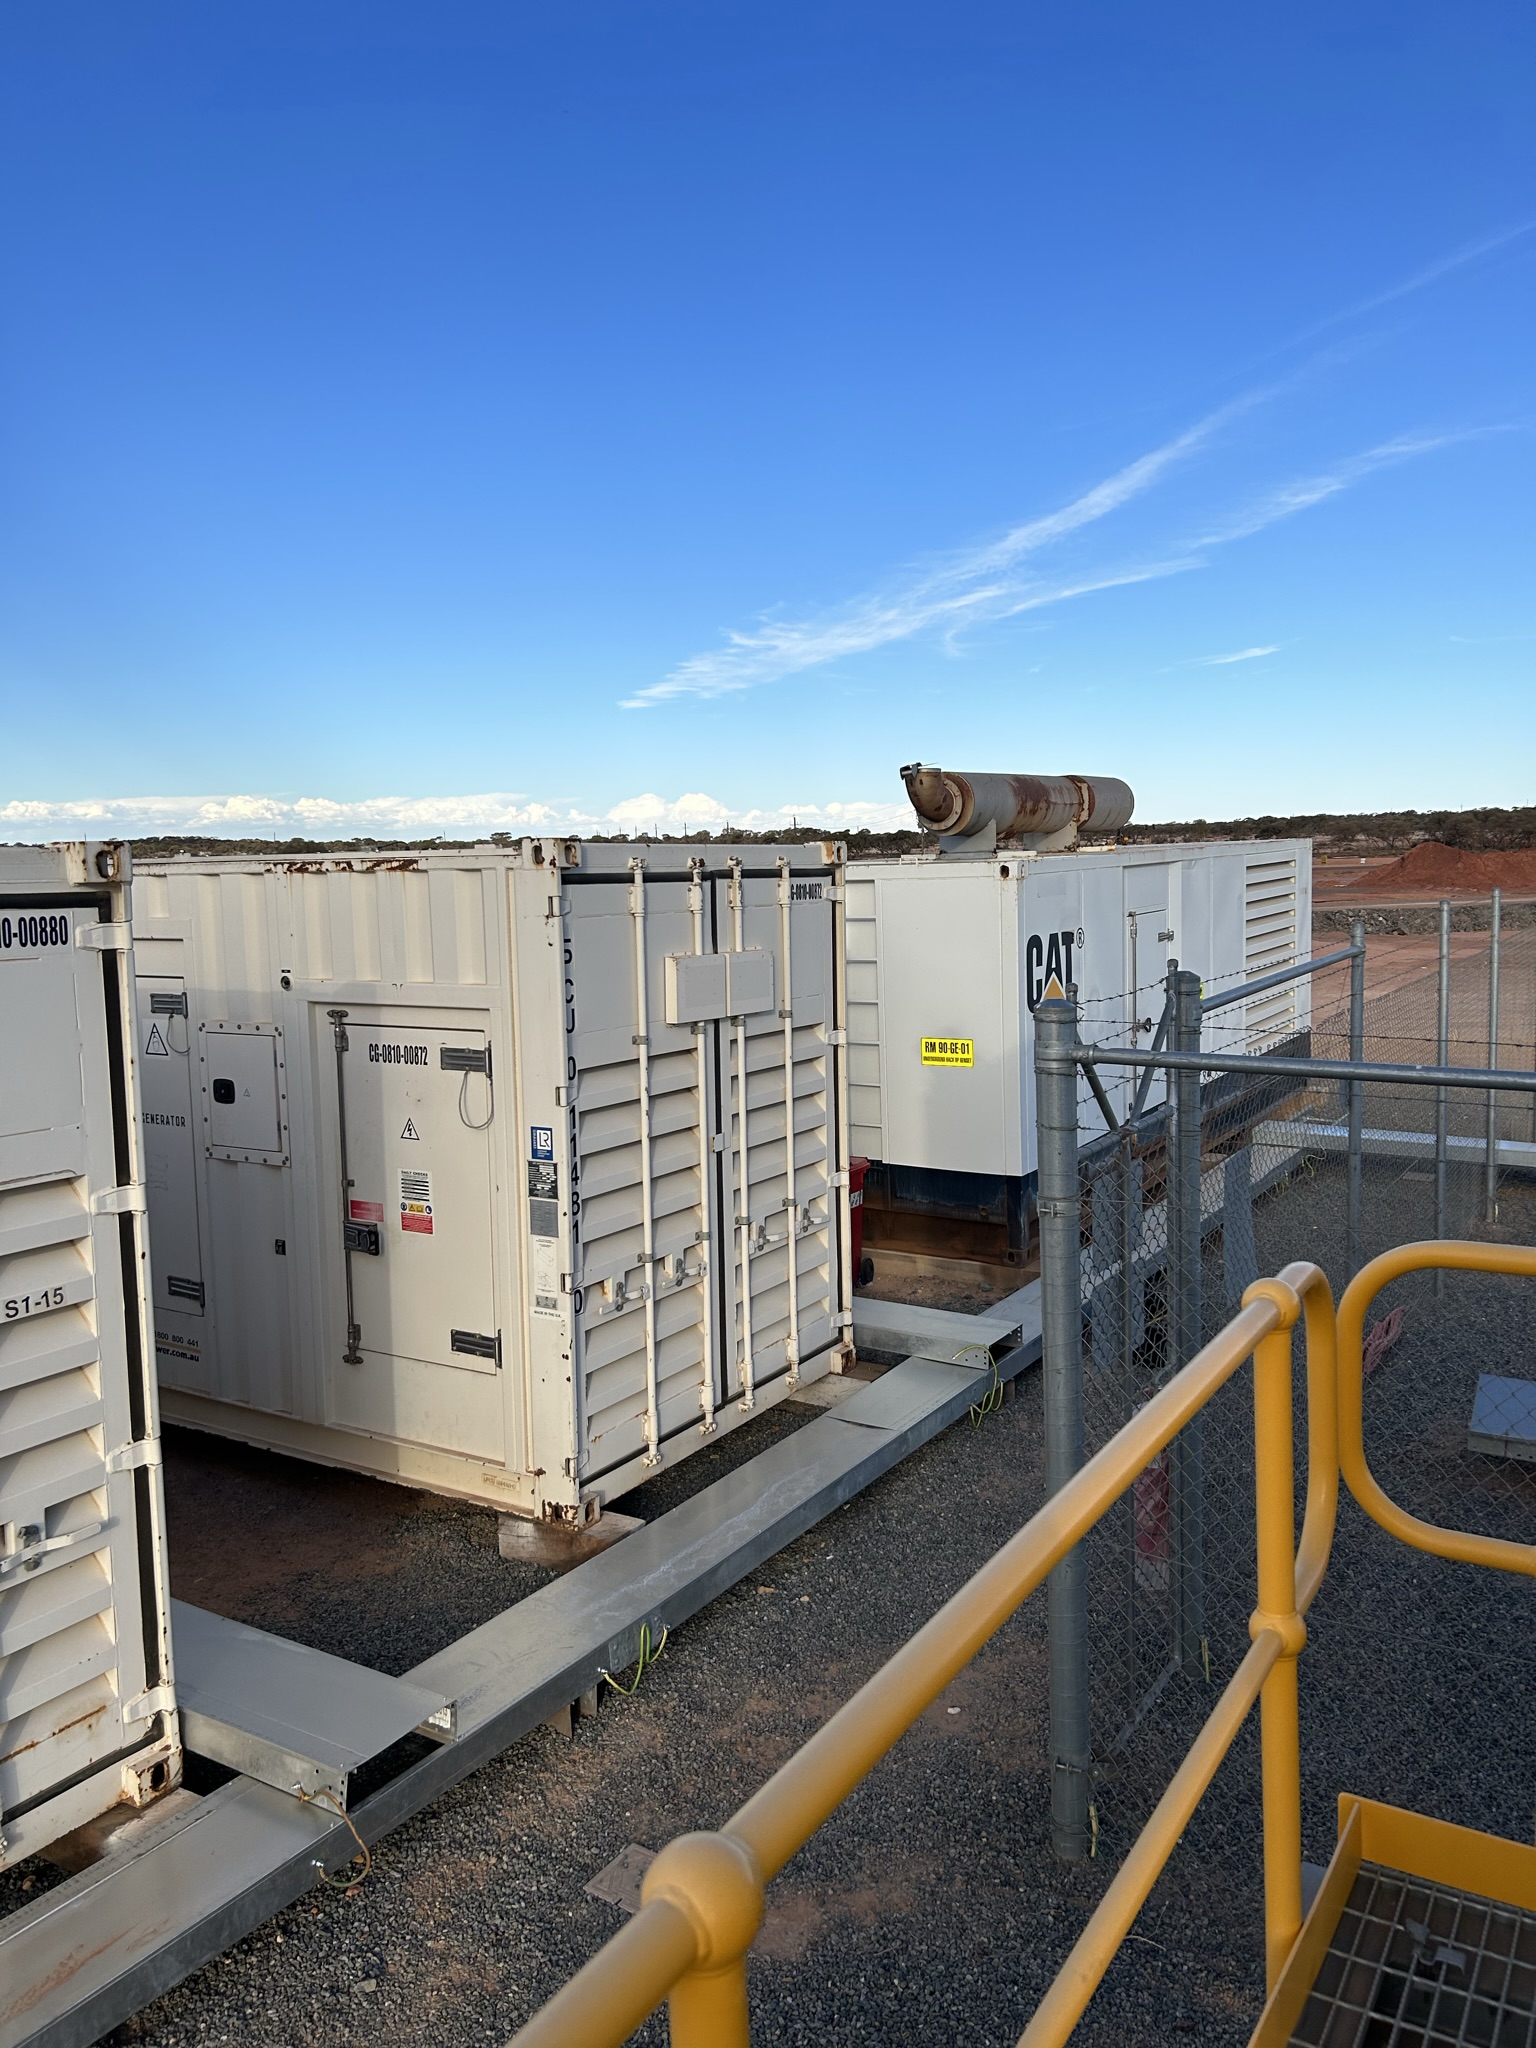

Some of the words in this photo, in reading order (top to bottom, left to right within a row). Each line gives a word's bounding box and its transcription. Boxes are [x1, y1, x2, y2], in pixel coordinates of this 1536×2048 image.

[0, 915, 69, 949] 0-00880
[369, 1043, 428, 1066] CG-0810-00872
[925, 1041, 936, 1053] RM
[938, 1041, 970, 1055] 90-GE-01
[539, 1131, 551, 1148] LR
[5, 1286, 64, 1319] S1-15
